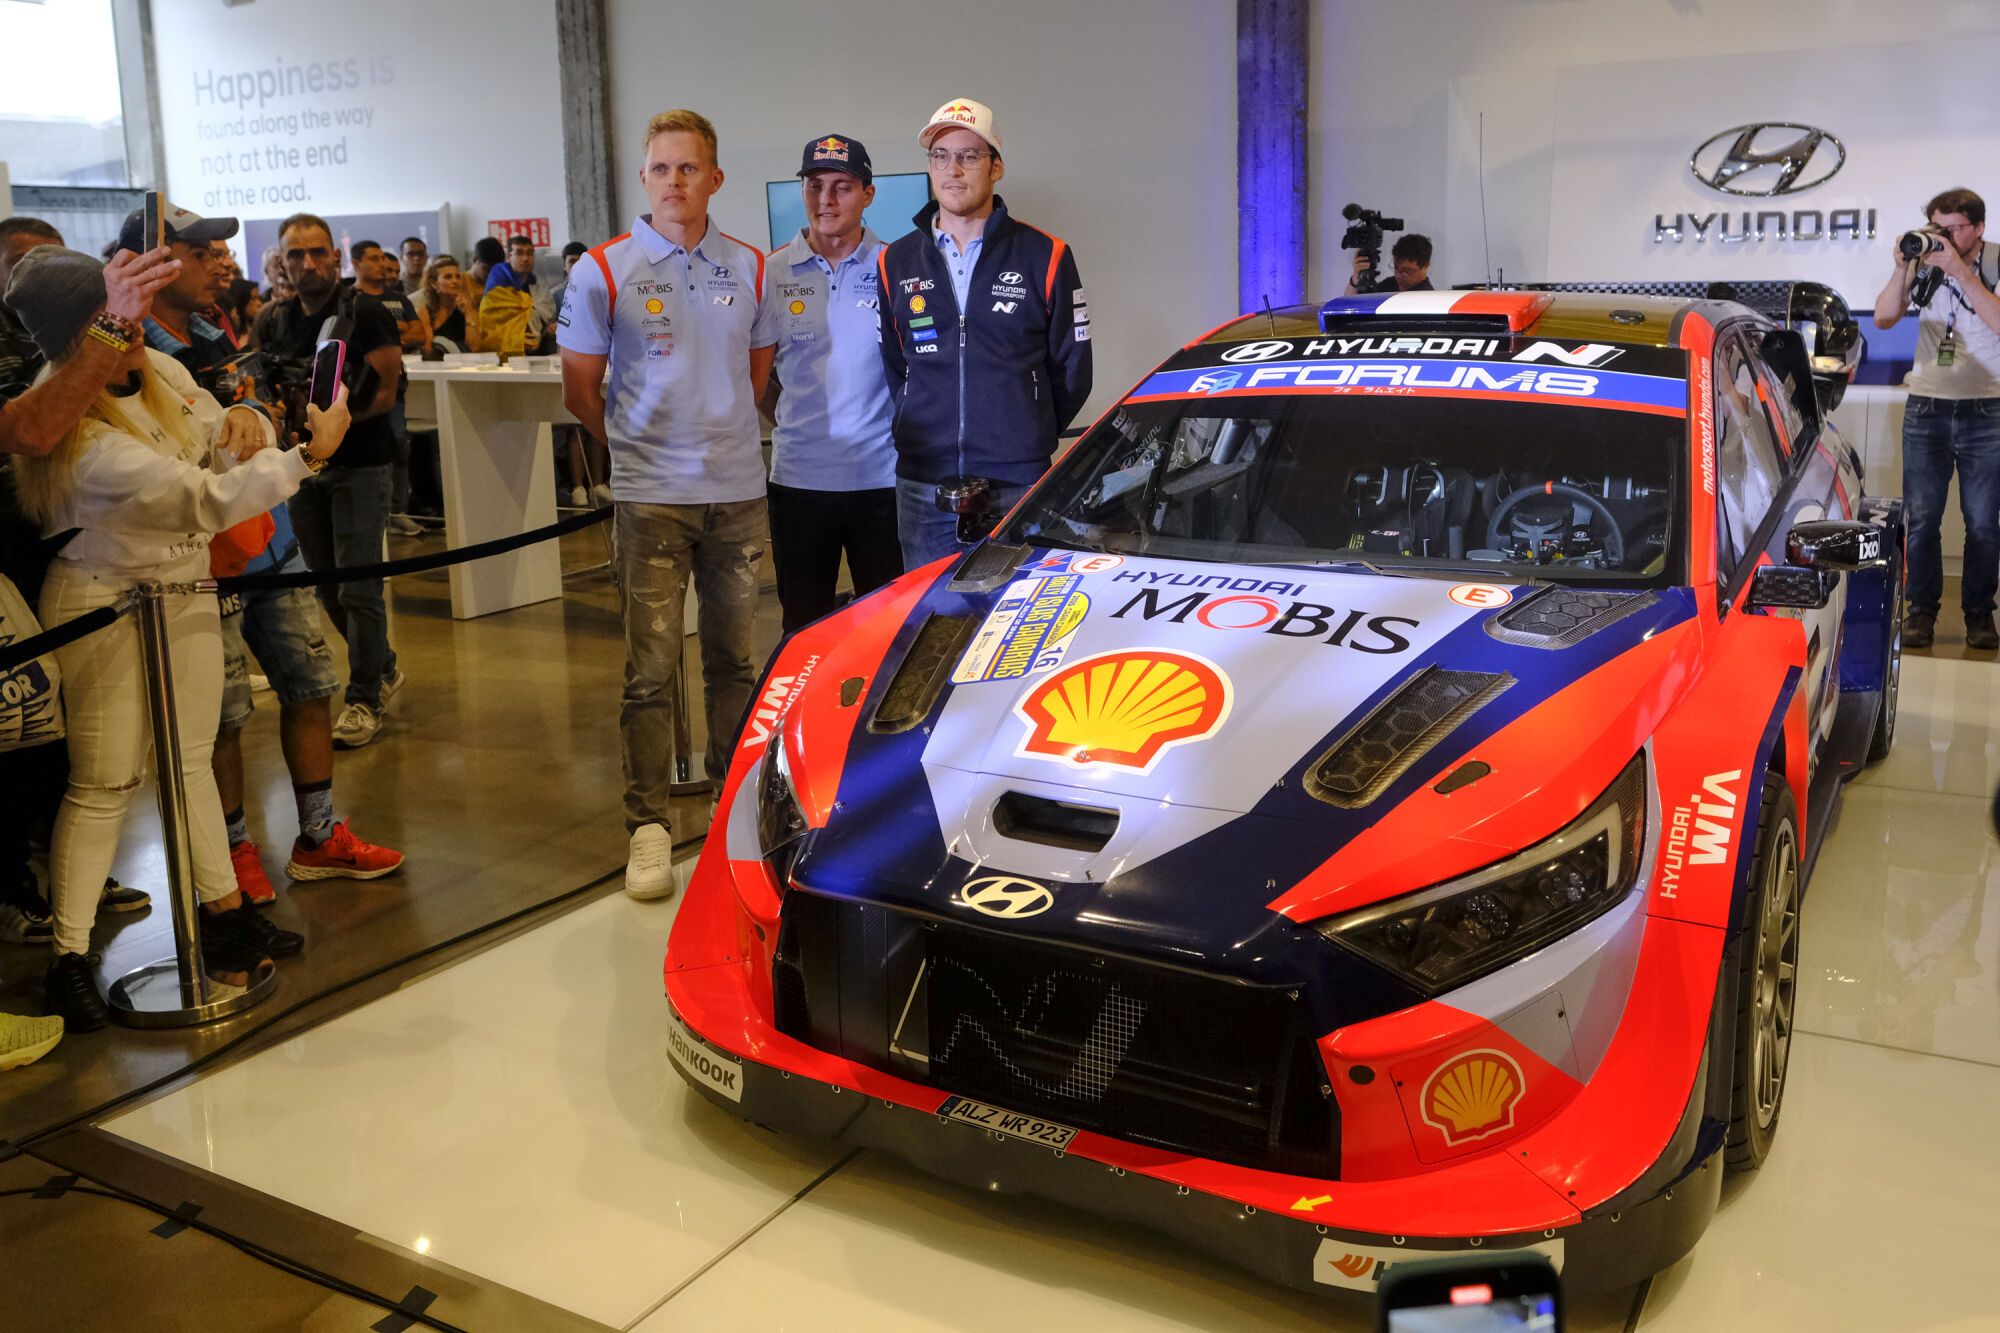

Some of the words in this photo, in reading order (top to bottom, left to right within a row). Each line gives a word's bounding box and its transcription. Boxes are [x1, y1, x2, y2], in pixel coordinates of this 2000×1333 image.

[193, 56, 361, 111] Happiness
[367, 54, 396, 88] is
[197, 116, 246, 141] found
[248, 113, 299, 136] along
[301, 106, 331, 130] the
[334, 105, 376, 129] way
[955, 113, 976, 125] Bull
[200, 150, 235, 176] not
[238, 147, 262, 173] at
[264, 143, 301, 171] the
[305, 135, 349, 168] end
[813, 150, 830, 161] Red
[830, 151, 849, 162] Bull
[203, 184, 222, 209] of
[225, 183, 256, 207] the
[260, 177, 312, 204] road.
[1654, 208, 1878, 244] HYUNDAI
[637, 283, 673, 296] MOBIS
[707, 279, 738, 287] HYUNDAI
[783, 286, 815, 298] MOBIS
[904, 279, 935, 294] MOBIS
[991, 284, 1027, 294] HYUNDAI
[991, 291, 1026, 299] MOTORSPORT
[1302, 337, 1500, 356] HYUNDAI
[1245, 364, 1600, 397] FORUM8
[1333, 386, 1416, 394] フォラムエイト
[1698, 356, 1714, 496] motorsport.hyundai.com
[1858, 533, 1879, 560] ixo
[1042, 575, 1071, 595] RALLY
[1112, 570, 1308, 597] HYUNDAI
[1024, 596, 1066, 622] ISLAS
[1108, 588, 1420, 655] MOBIS
[993, 622, 1049, 679] CANARIAS
[1034, 646, 1064, 669] 16
[1659, 806, 1692, 899] HYUNDAI
[954, 1102, 999, 1124] ALZ
[999, 1114, 1030, 1133] WR
[1027, 1122, 1072, 1144] 923
